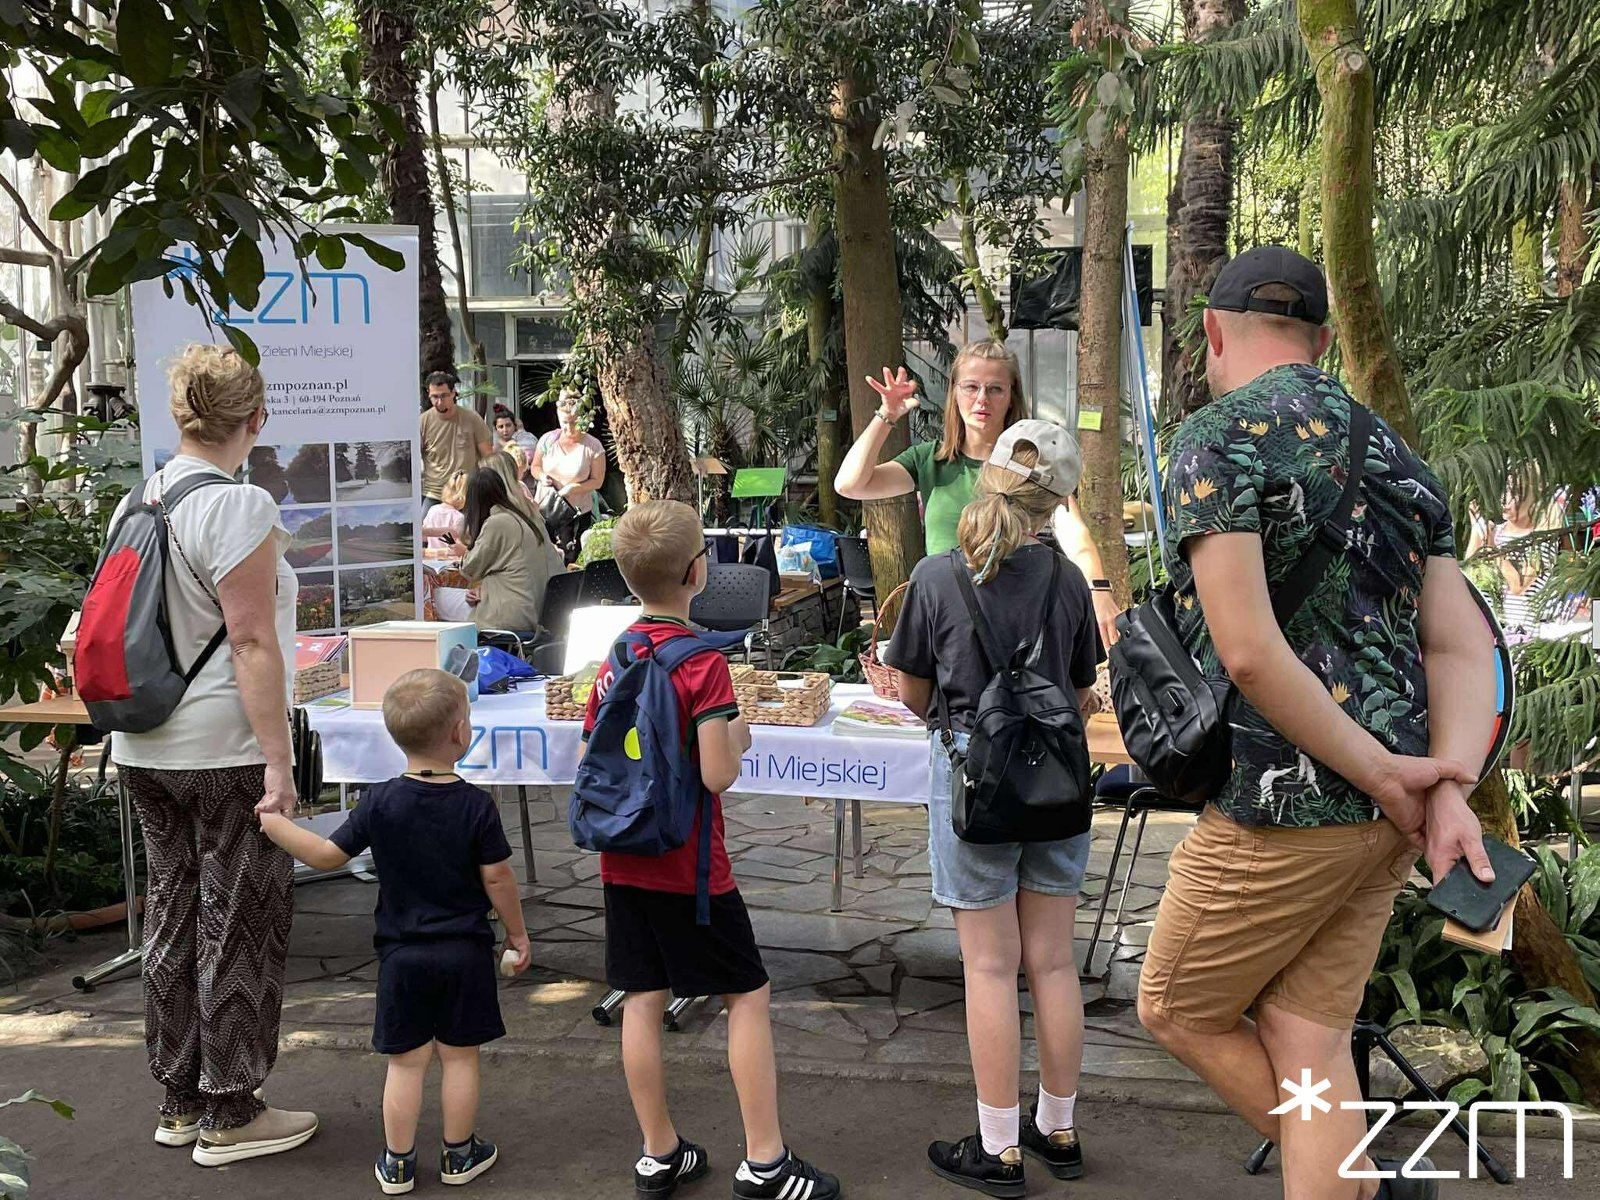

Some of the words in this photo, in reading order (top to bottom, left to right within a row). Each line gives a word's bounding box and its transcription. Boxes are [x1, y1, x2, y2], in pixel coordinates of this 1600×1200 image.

[261, 345, 298, 357] Zieleni
[300, 345, 353, 358] Miejskiej
[266, 379, 348, 394] zmpoznan.pl
[266, 395, 282, 404] ska
[299, 393, 326, 404] 60-194
[329, 393, 362, 403] Poznań
[272, 405, 386, 417] kancelaria@zzmpoznan.pl
[457, 726, 548, 770] zm
[739, 753, 759, 778] ni
[769, 754, 887, 791] Miejskiej
